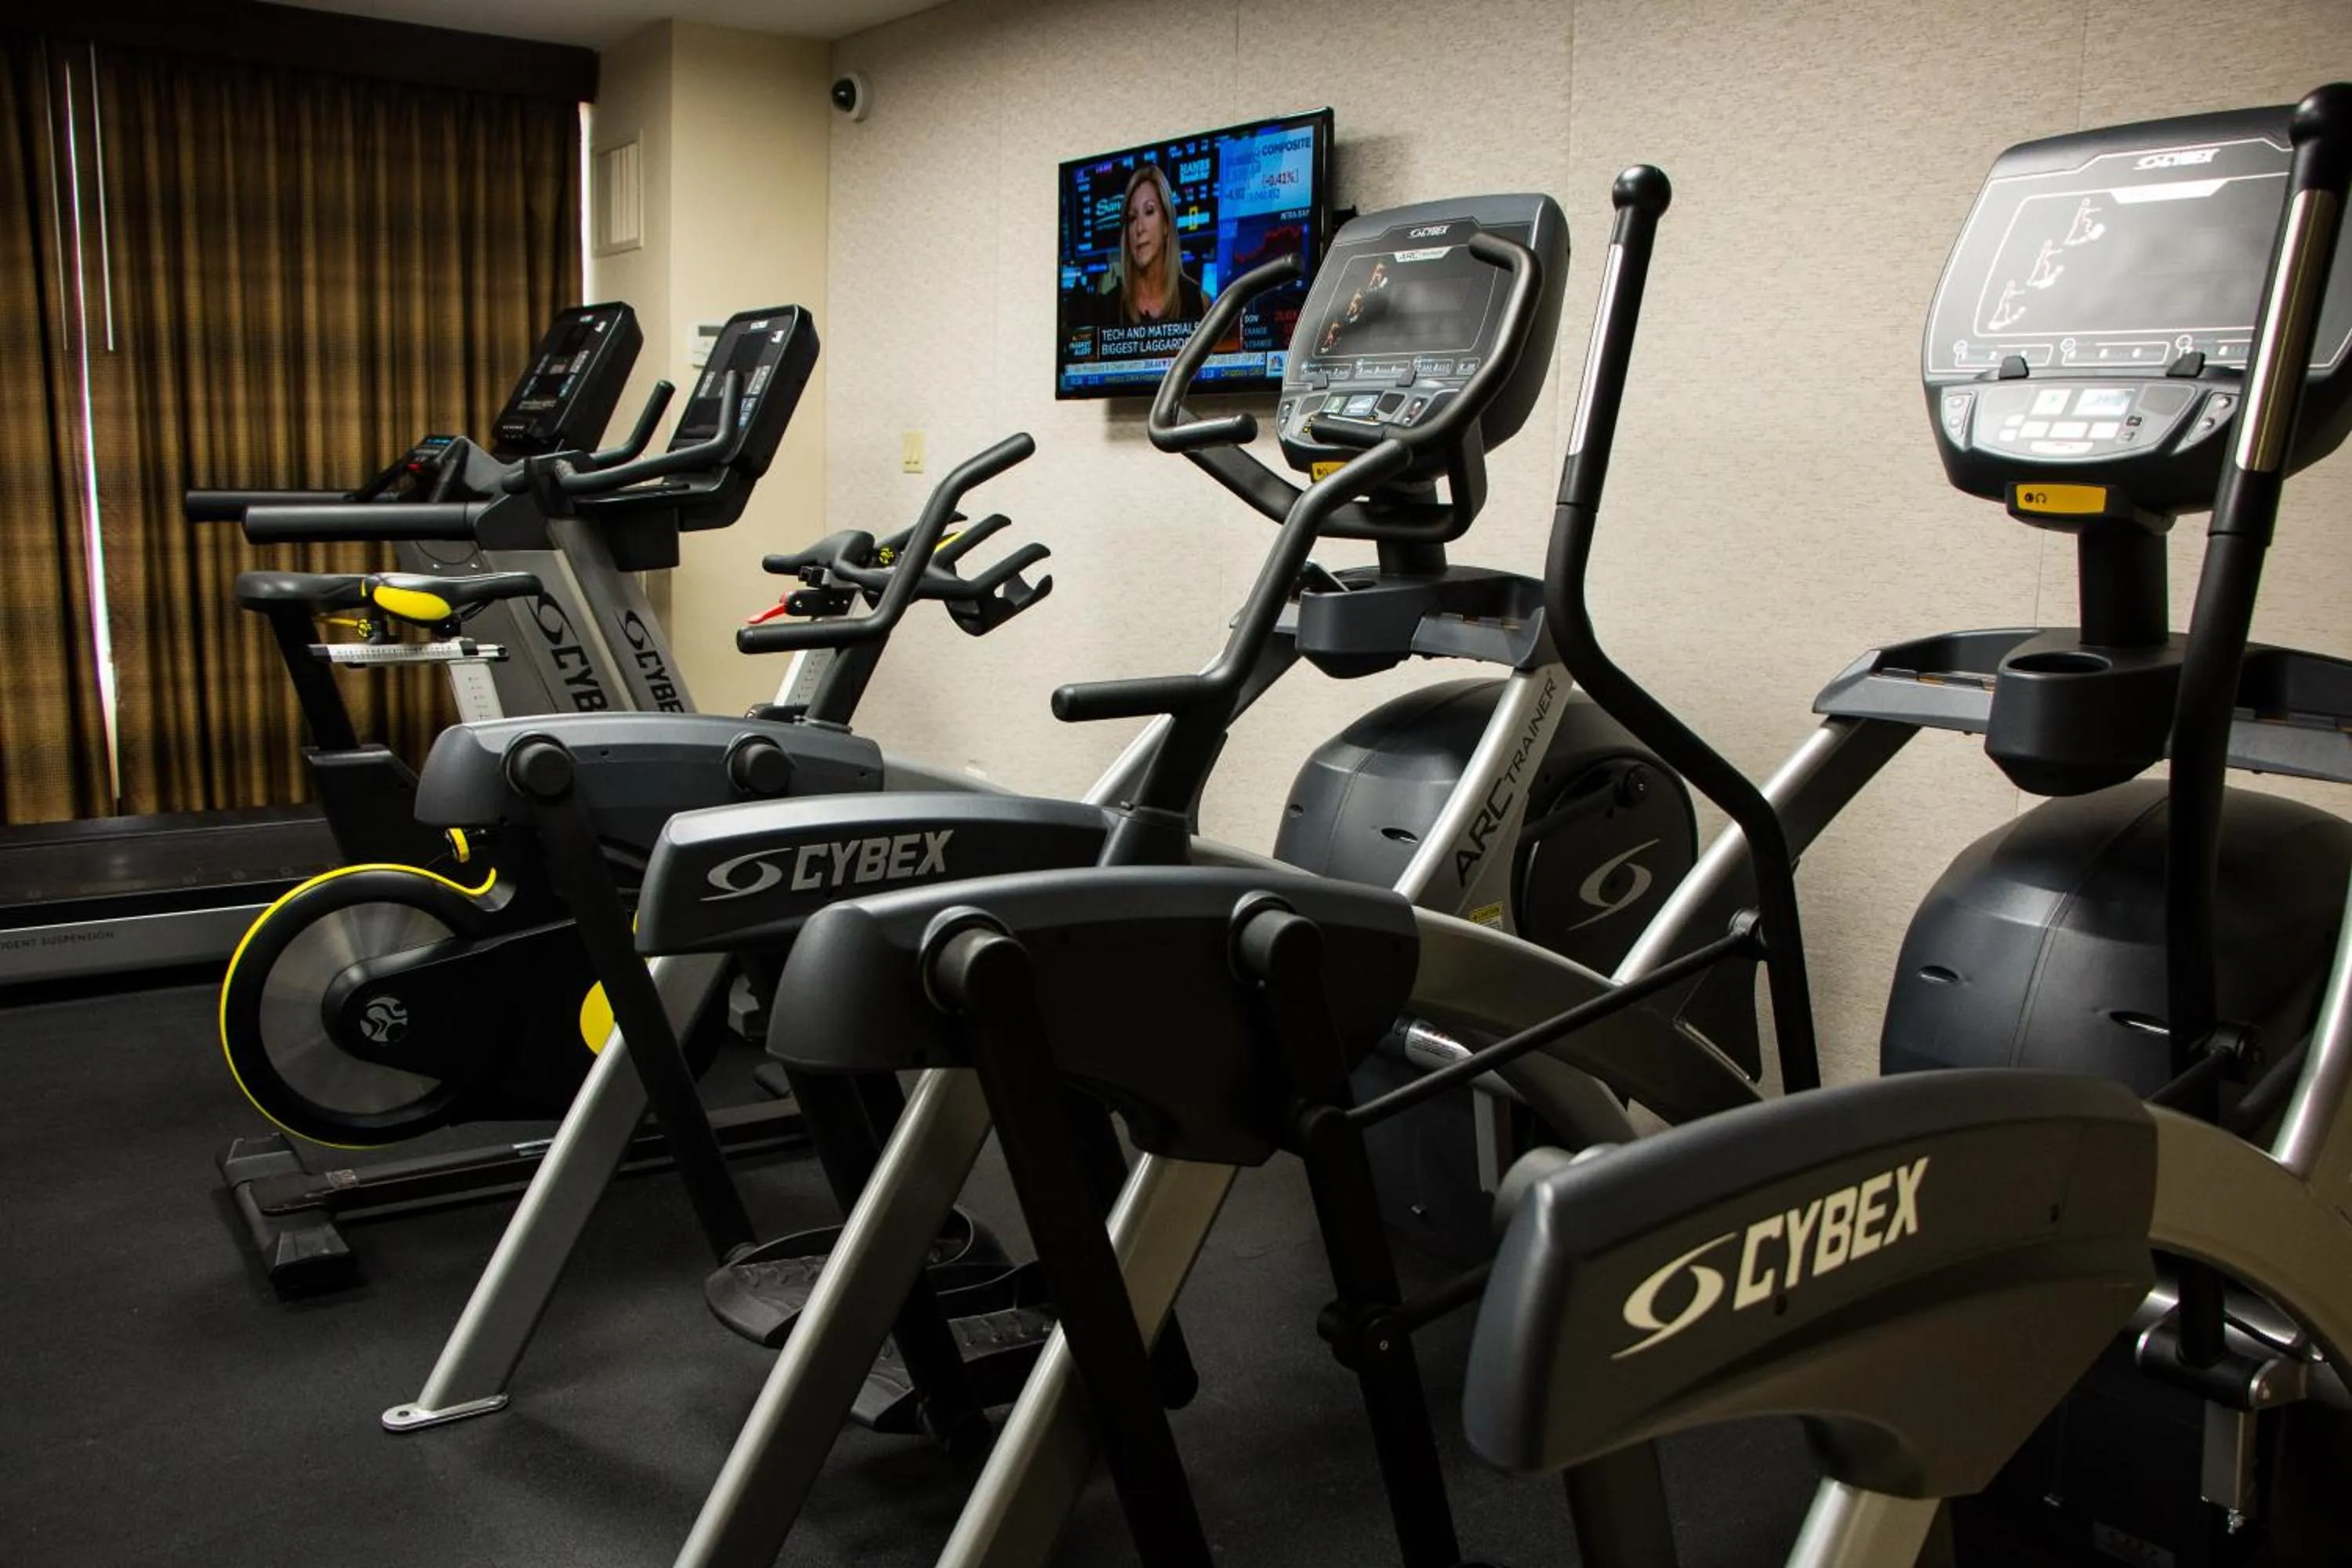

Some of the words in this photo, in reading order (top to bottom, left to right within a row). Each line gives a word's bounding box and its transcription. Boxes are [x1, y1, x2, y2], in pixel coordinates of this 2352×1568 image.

[1261, 136, 1312, 156] COMPOSITE
[1102, 328, 1125, 342] TECH
[1126, 327, 1145, 339] AND
[1102, 341, 1139, 355] BIGGEST
[551, 645, 609, 713] CYB
[634, 650, 684, 713] CYBE
[1456, 778, 1514, 888] ARC
[1503, 677, 1559, 783] TRAINER
[791, 829, 954, 891] CYBEX
[1733, 1156, 1930, 1312] CYBEX
